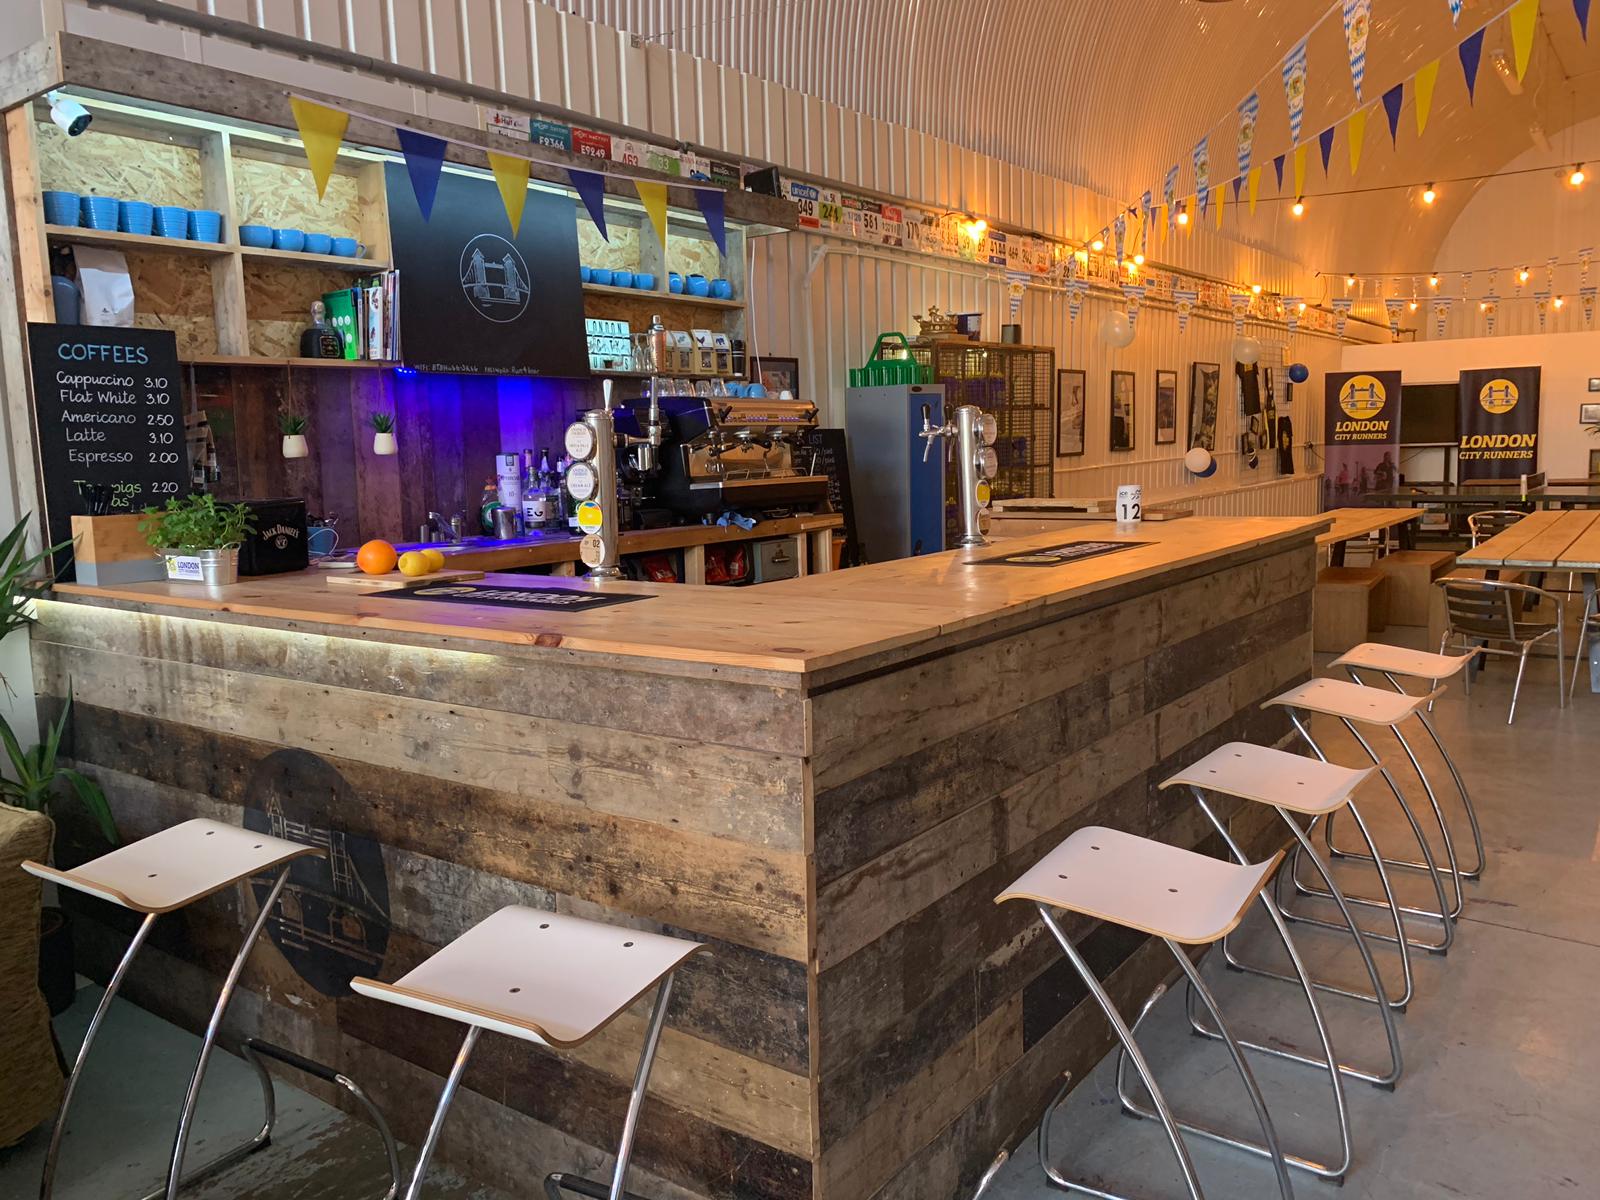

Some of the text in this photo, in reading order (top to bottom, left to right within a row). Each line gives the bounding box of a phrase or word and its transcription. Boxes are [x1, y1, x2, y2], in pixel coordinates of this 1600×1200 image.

[580, 145, 606, 158] E9249
[799, 199, 814, 216] 349
[863, 213, 878, 230] 581
[58, 343, 149, 365] COFFEES
[56, 370, 168, 390] Cappuccino 3.10
[60, 389, 170, 405] Flat White 3.10
[61, 410, 174, 426] Americano 2.50
[1335, 421, 1390, 432] LONDON
[66, 427, 174, 444] Latte 3.10
[1460, 434, 1537, 448] LONDON
[69, 449, 179, 468] Espresso 2.00
[1459, 451, 1534, 459] CITY RUNNERS
[152, 482, 179, 493] 2.20
[1121, 503, 1140, 520] 12
[177, 561, 200, 570] LONDON
